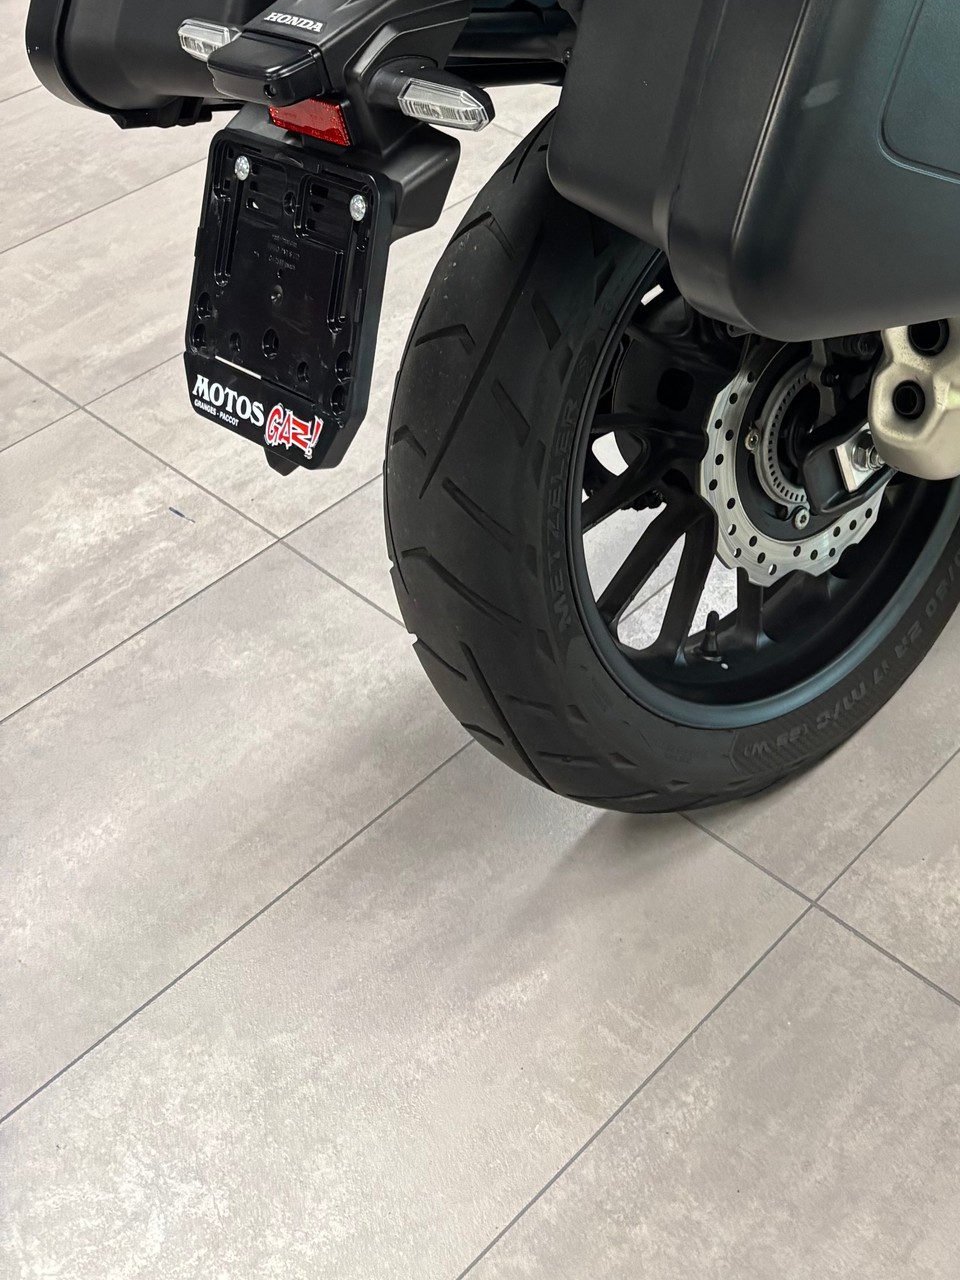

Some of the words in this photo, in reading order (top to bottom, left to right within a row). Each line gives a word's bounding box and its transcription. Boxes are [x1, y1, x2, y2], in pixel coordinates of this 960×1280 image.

[263, 12, 323, 33] HONDA
[192, 374, 265, 427] MOTOS
[194, 398, 217, 417] GRANGES
[220, 411, 240, 428] PACCOT
[551, 397, 578, 629] METZELER
